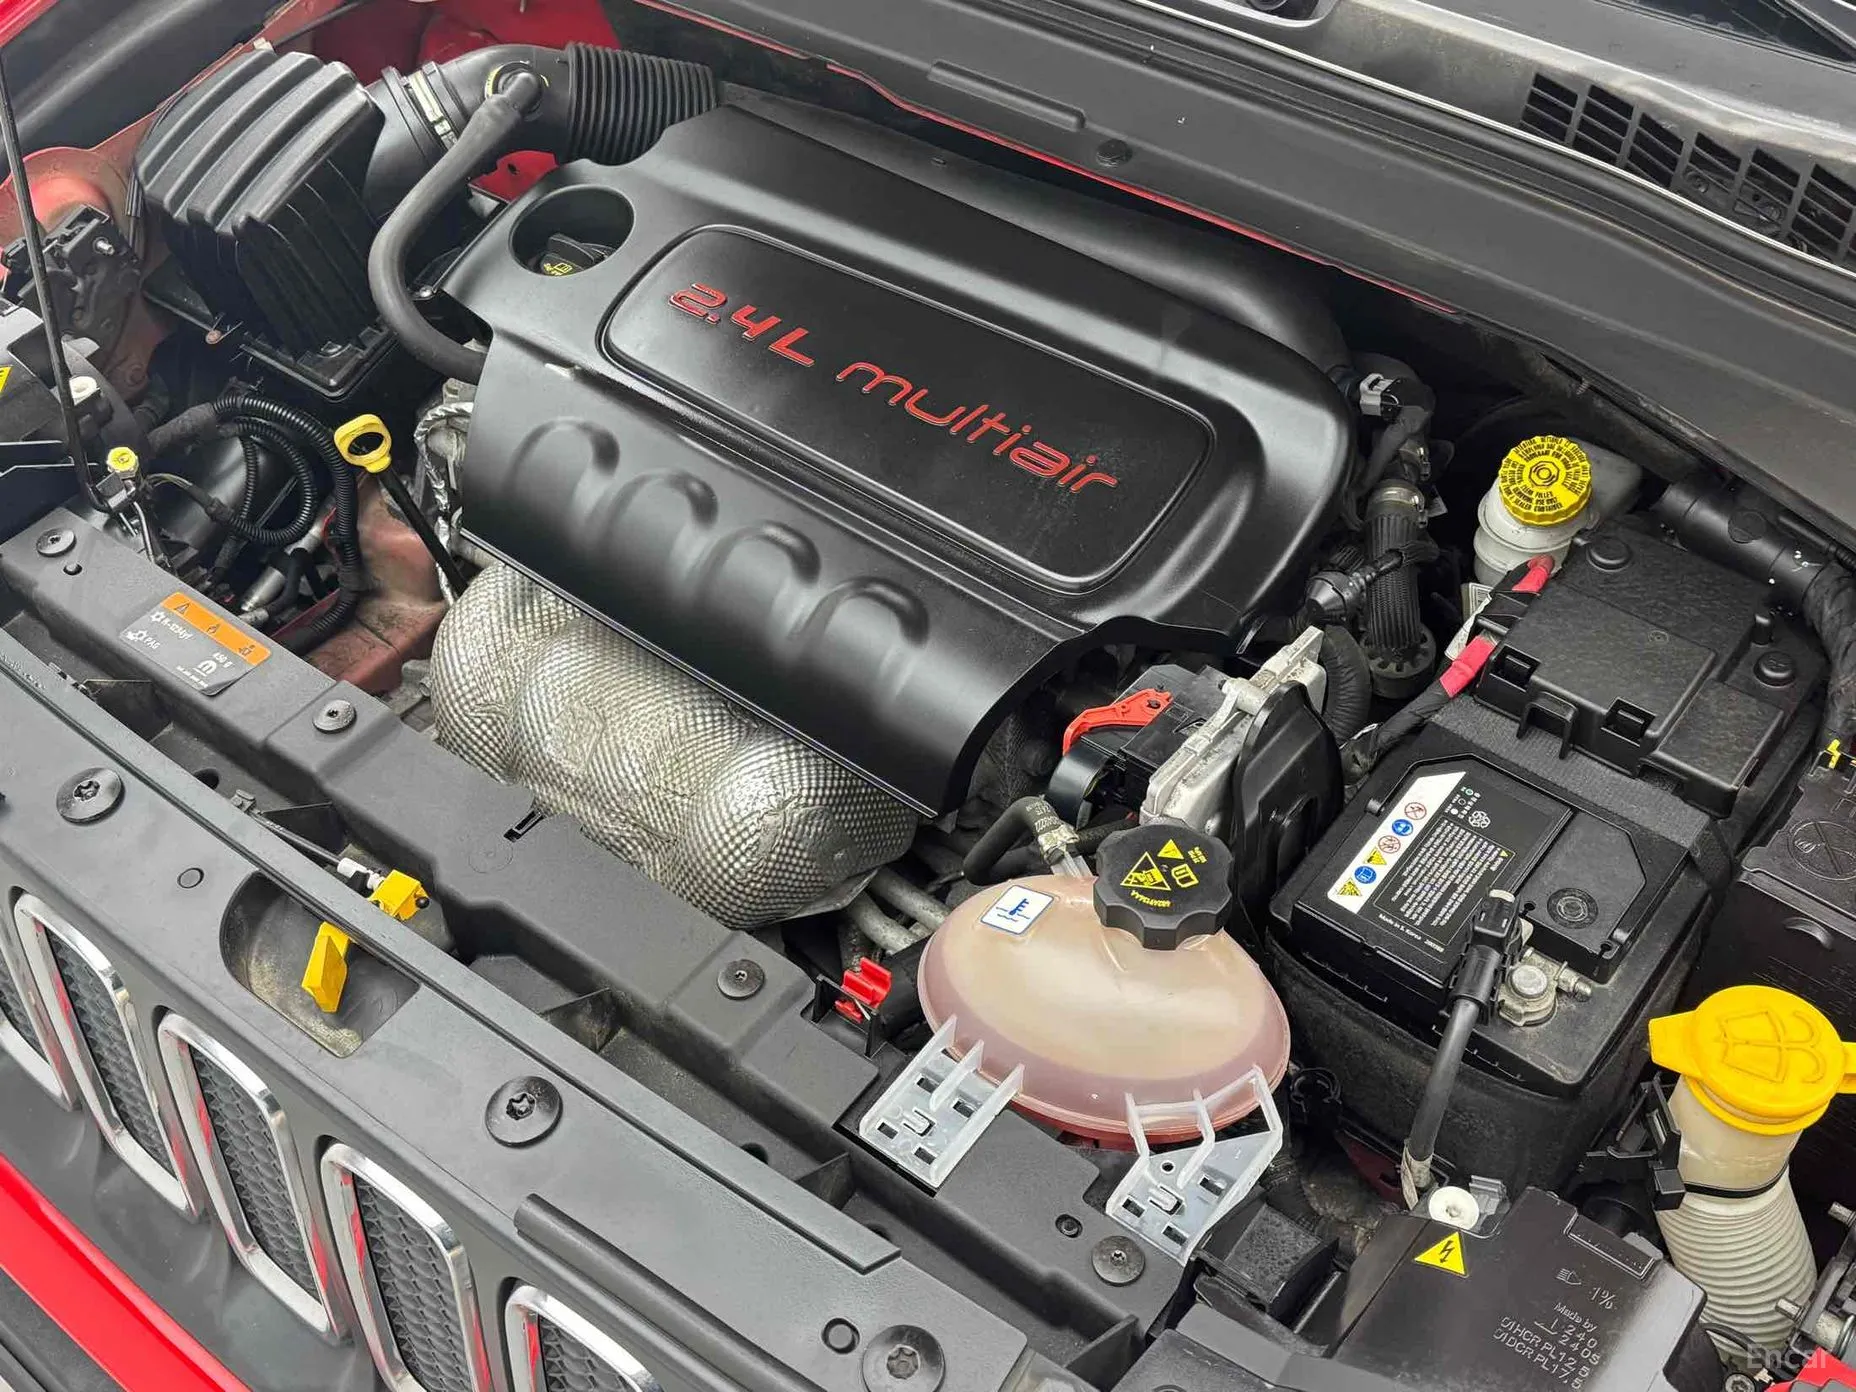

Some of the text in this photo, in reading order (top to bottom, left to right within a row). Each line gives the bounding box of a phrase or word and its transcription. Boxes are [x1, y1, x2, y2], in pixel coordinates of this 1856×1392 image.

[668, 282, 1118, 493] 2.4L multiair
[1554, 1302, 1598, 1333] Made by
